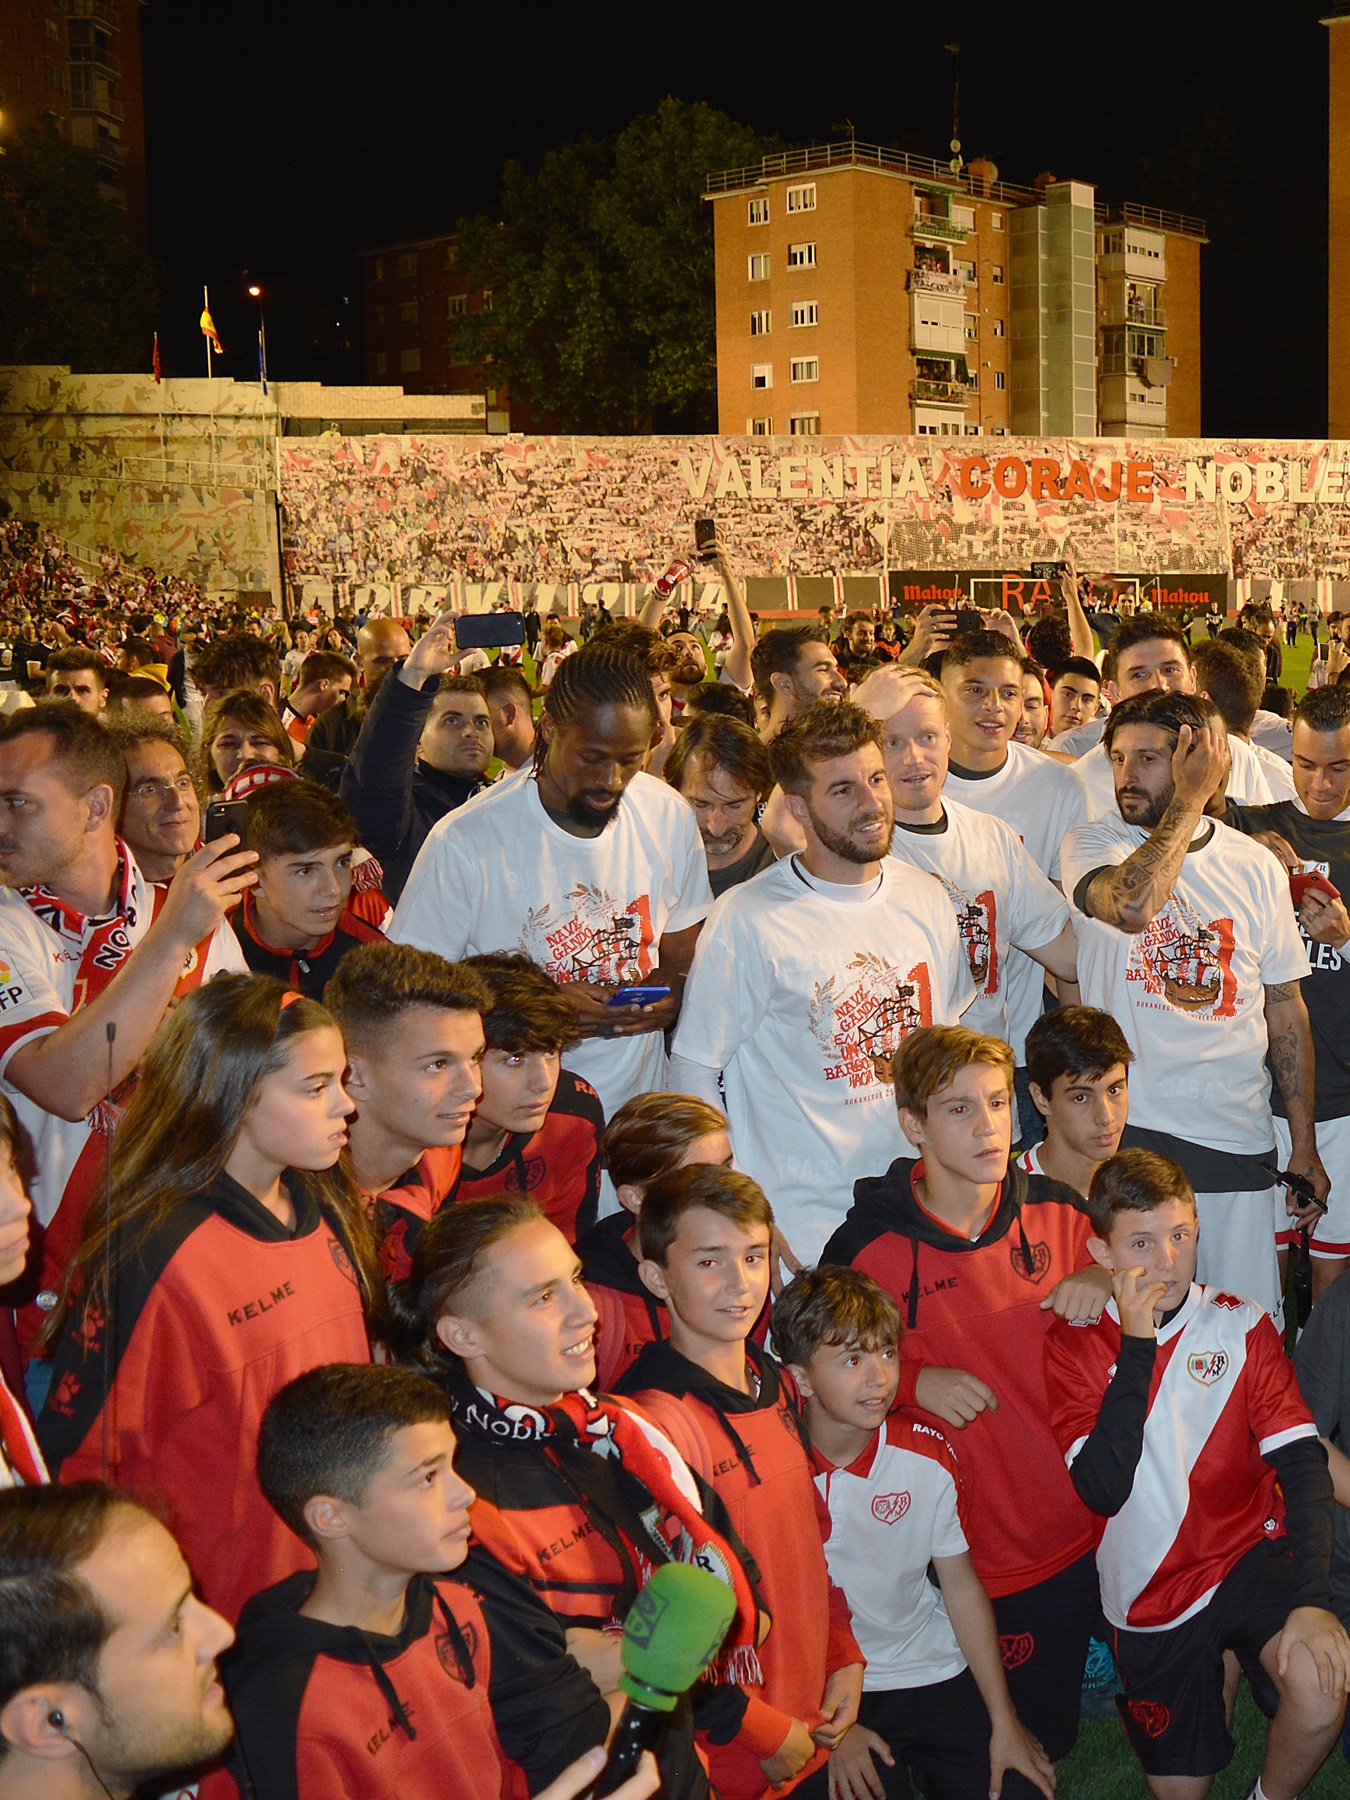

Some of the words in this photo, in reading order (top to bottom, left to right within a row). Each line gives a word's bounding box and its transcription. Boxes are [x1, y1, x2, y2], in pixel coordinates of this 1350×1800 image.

[680, 444, 930, 499] VALENTÍA
[960, 456, 1153, 502] CORAJE
[903, 584, 961, 601] Mahou
[1151, 588, 1210, 604] Mahou
[552, 927, 594, 960] GANDO
[1144, 928, 1180, 947] GANDO
[545, 960, 569, 973] EN
[839, 996, 881, 1032] GANDO
[1136, 1000, 1175, 1012] BUKANEROS
[833, 1032, 856, 1045] EN
[840, 1041, 861, 1062] UN
[844, 1094, 883, 1106] BUKANEROS
[227, 1281, 296, 1326] KELME
[912, 1423, 944, 1441] RAYO
[712, 1444, 756, 1477] KELE
